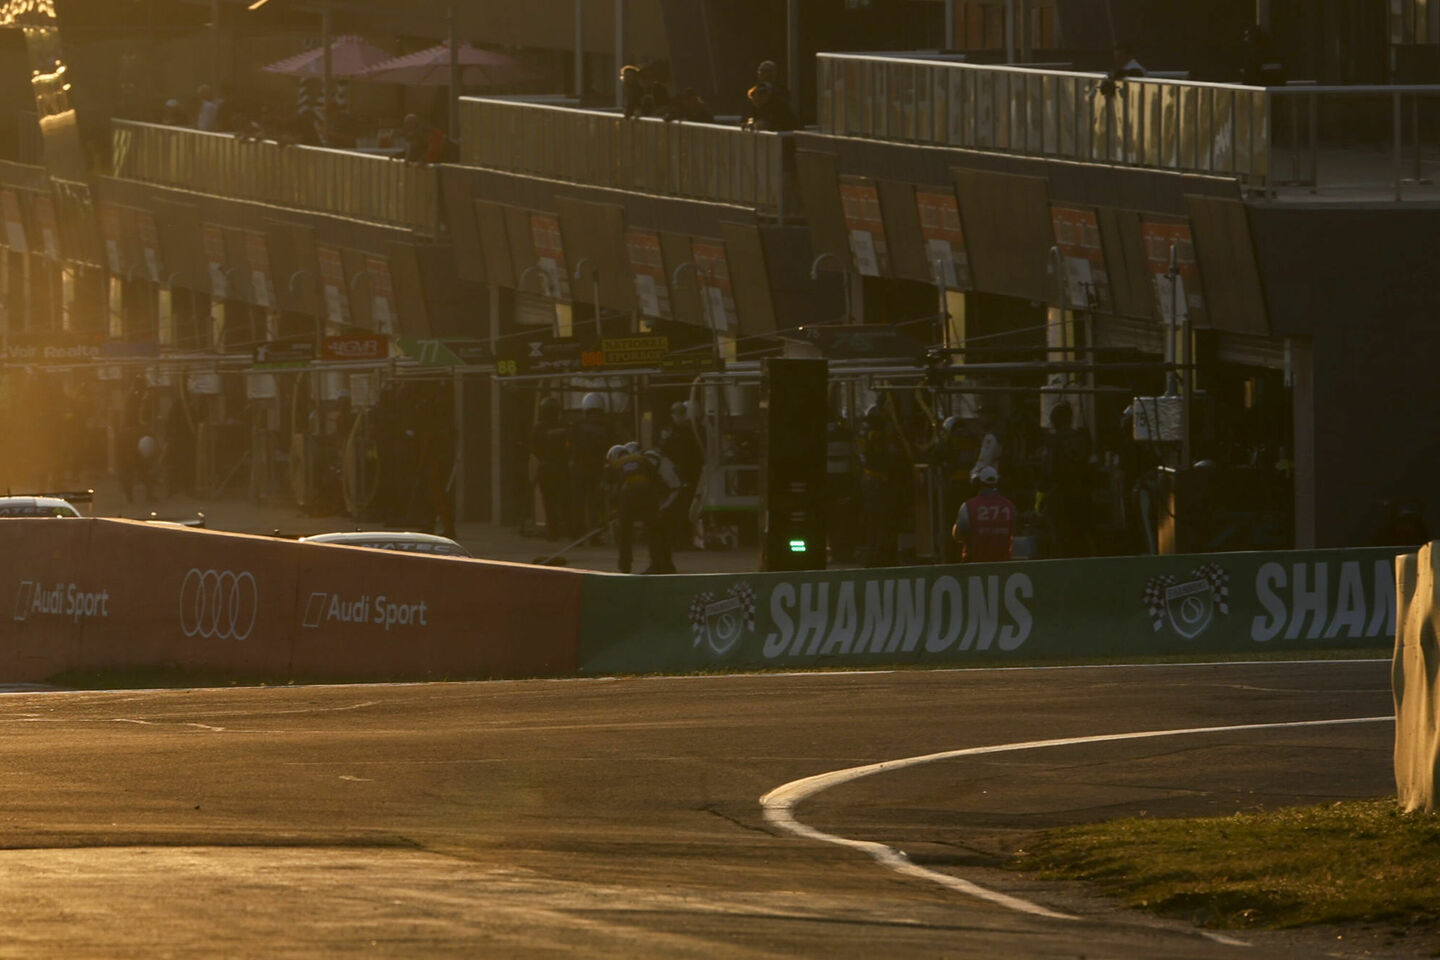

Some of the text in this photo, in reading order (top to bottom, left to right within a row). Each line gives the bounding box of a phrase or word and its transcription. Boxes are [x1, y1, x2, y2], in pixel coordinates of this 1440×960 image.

[416, 339, 441, 363] 77
[976, 505, 1010, 521] 271
[32, 581, 110, 624] Audi Sport
[326, 593, 428, 631] Audi Sport
[763, 572, 1033, 659] SHANNONS
